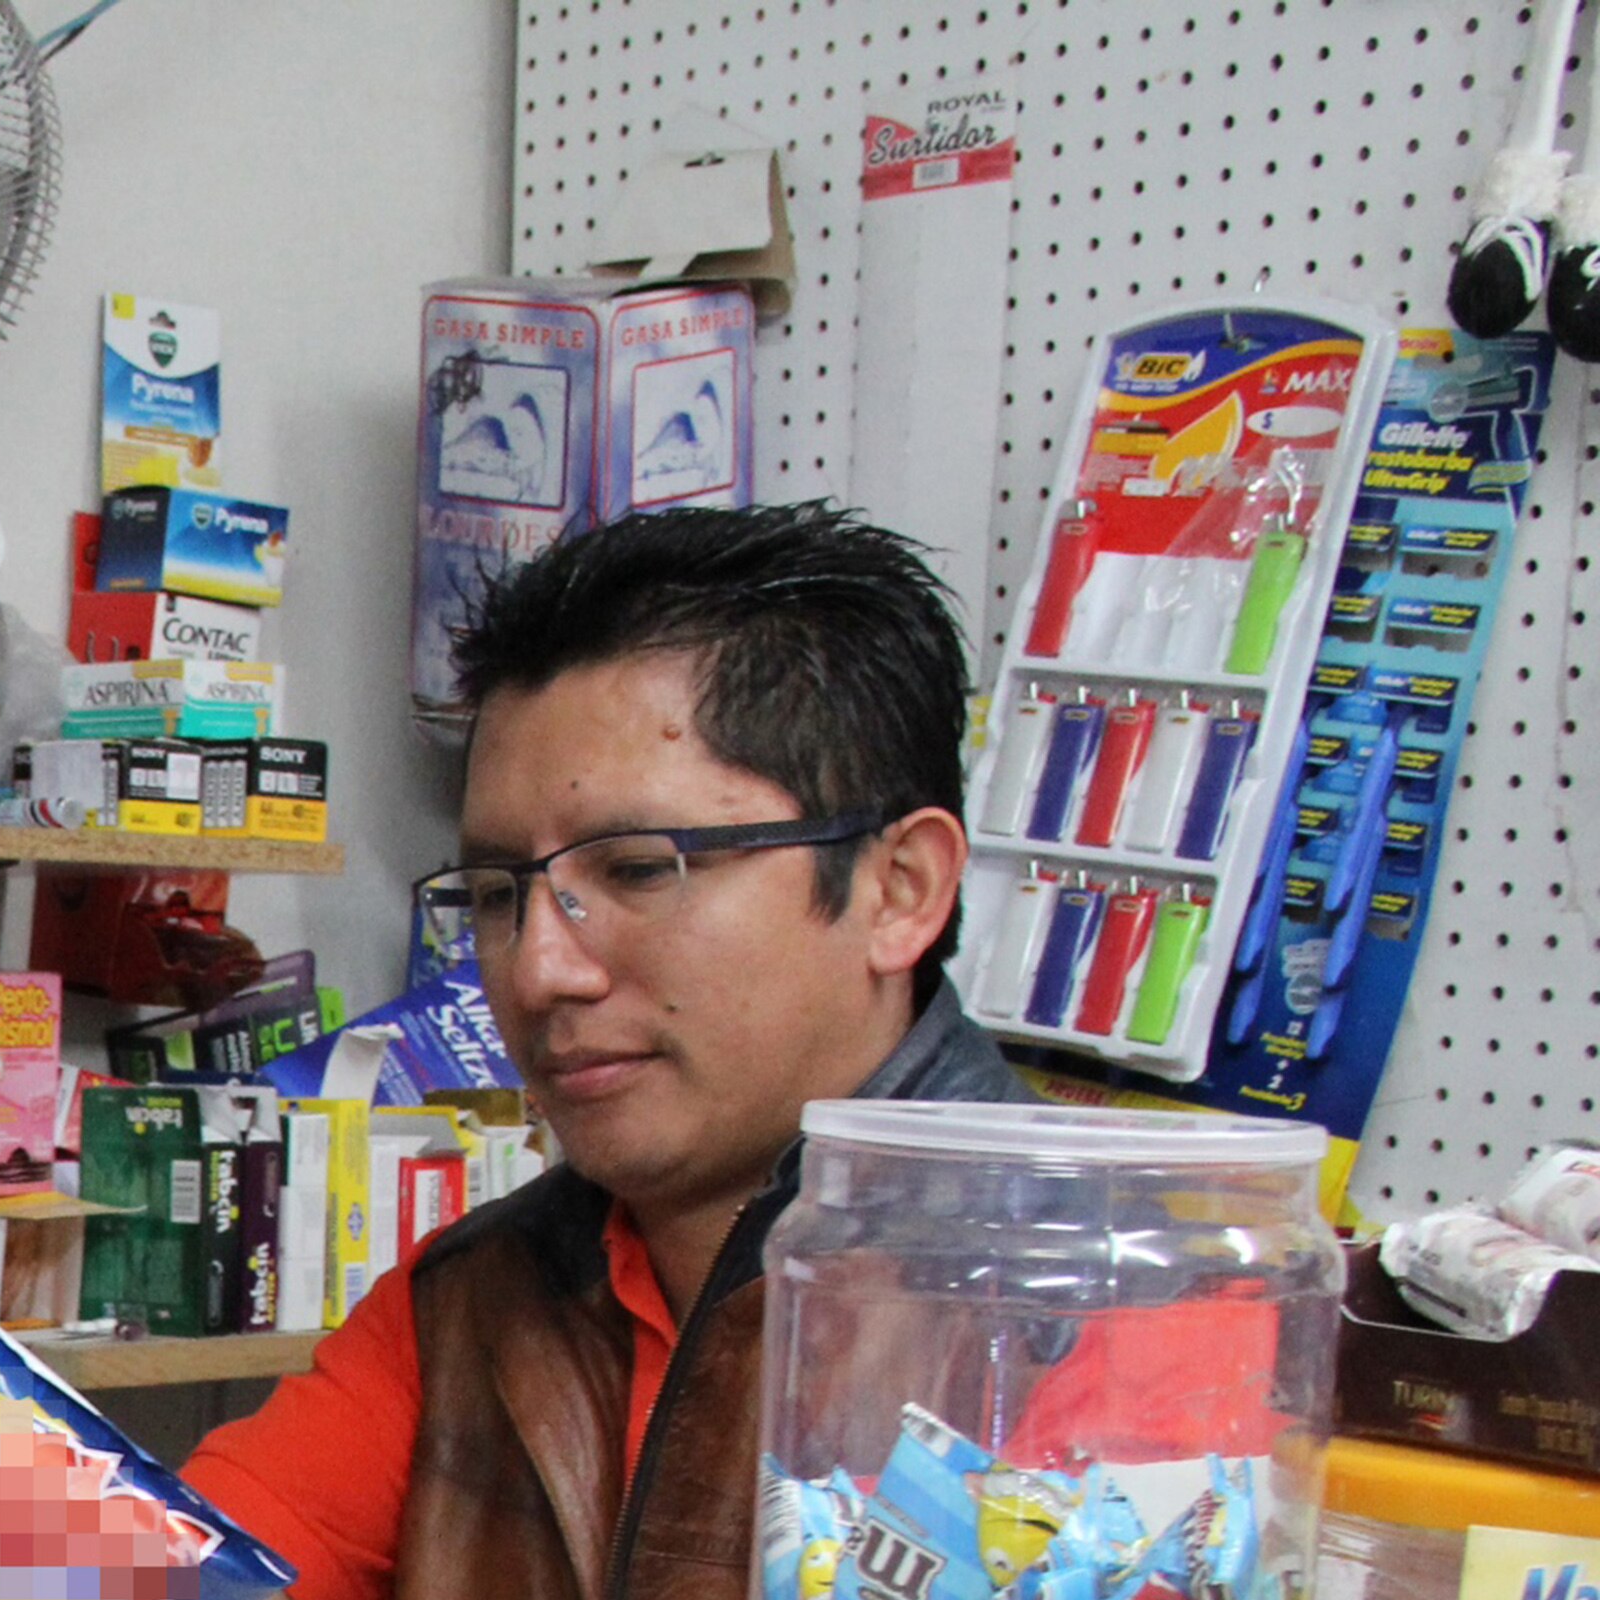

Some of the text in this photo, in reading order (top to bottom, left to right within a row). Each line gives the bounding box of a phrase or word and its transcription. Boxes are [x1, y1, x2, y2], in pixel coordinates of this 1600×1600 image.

[928, 90, 1005, 113] ROYAL
[866, 115, 996, 166] Surtidor
[434, 318, 586, 349] GASA SIMPLE
[622, 309, 744, 346] GASA SIMPLE
[131, 372, 195, 403] Pyrena
[1379, 422, 1472, 448] Gillette
[1363, 469, 1450, 494] UltraGrip
[215, 508, 269, 533] Pyrena
[162, 618, 250, 653] CONTAC
[84, 679, 171, 706] ASPIRINA
[260, 747, 306, 763] SONY
[215, 1151, 240, 1234] tabcin
[248, 1242, 271, 1326] tabcin
